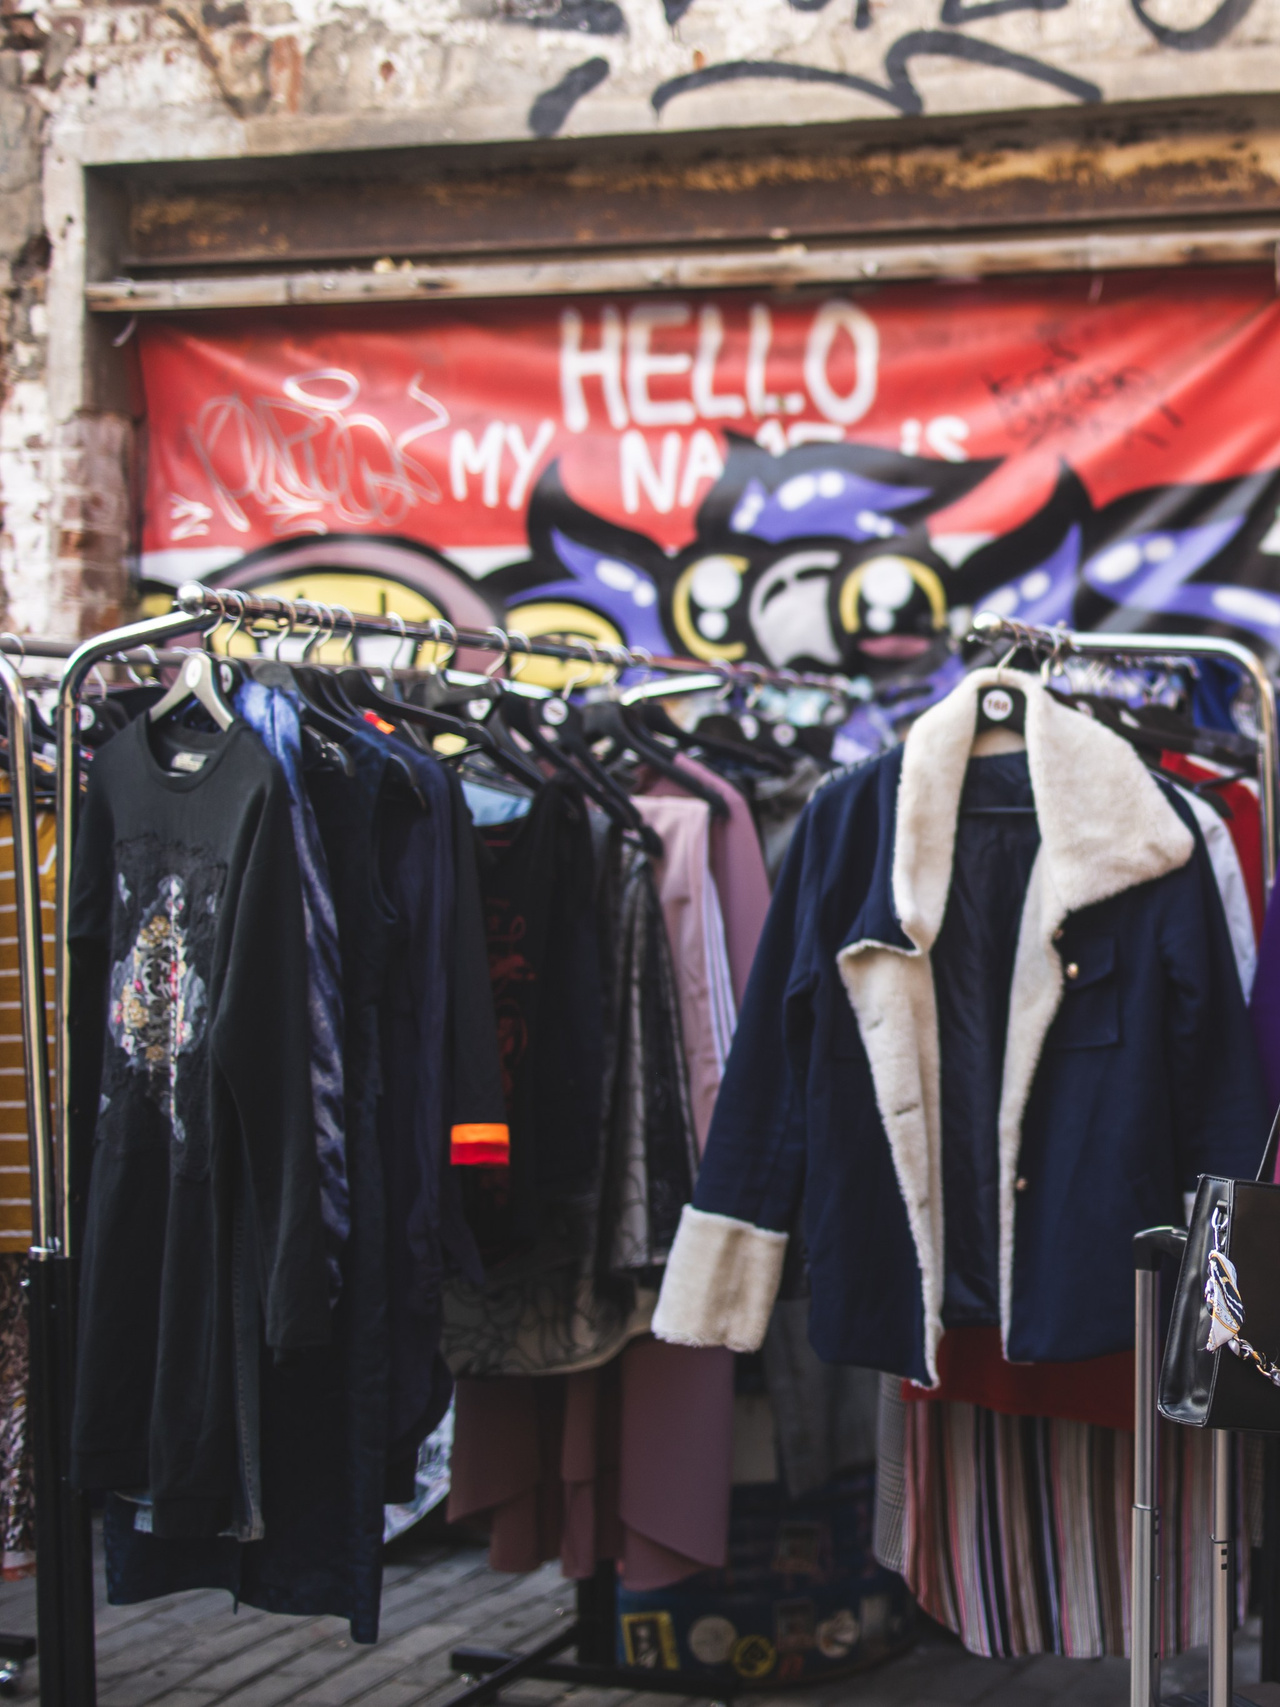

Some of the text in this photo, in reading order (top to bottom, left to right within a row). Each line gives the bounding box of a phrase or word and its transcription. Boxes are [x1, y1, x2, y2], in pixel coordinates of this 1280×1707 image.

[560, 301, 880, 432] HELLO
[452, 419, 556, 511] MY
[620, 420, 846, 514] NA
